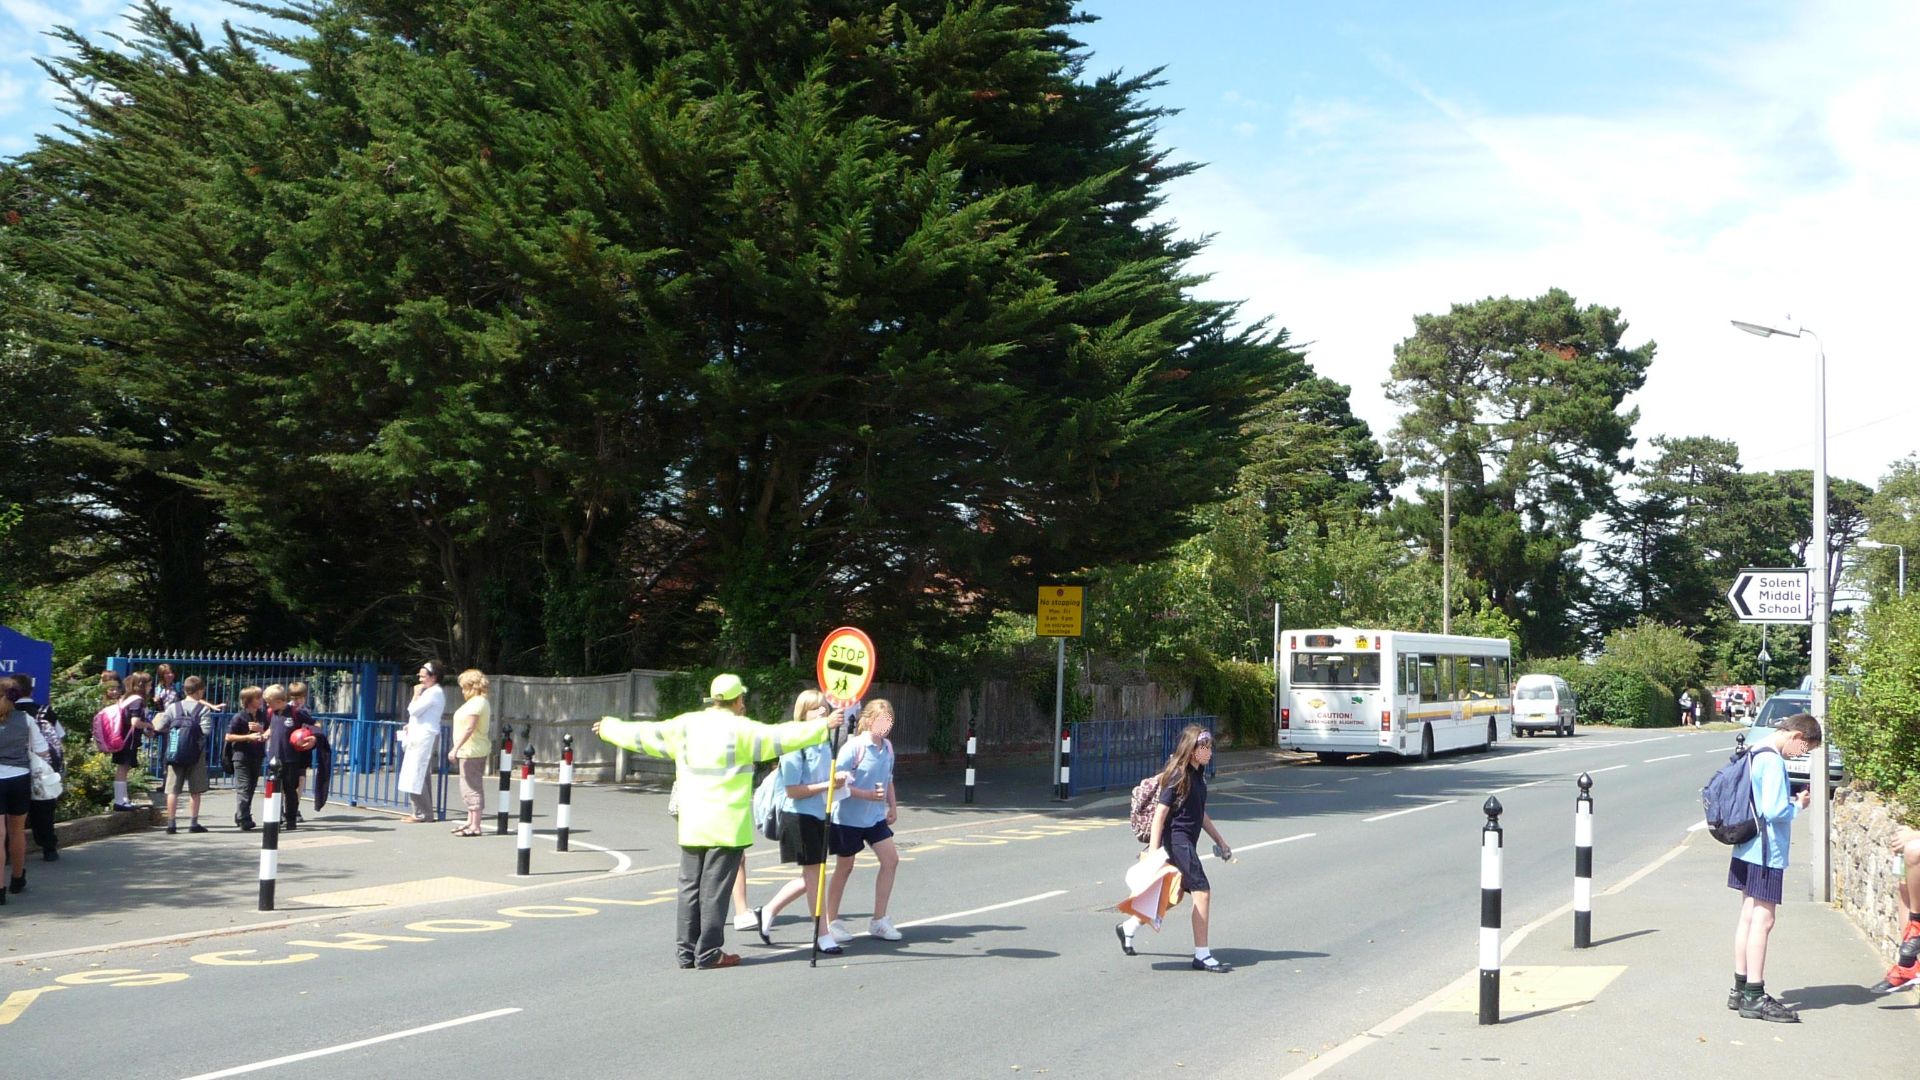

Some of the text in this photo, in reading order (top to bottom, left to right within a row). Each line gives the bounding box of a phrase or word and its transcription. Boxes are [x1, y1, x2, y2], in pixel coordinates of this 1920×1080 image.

[1759, 577, 1801, 588] Solent
[1759, 590, 1801, 601] Middle
[1051, 599, 1080, 607] stopping
[1758, 603, 1802, 614] School
[831, 645, 865, 662] STOP
[1316, 712, 1353, 720] CAUTION!
[55, 896, 677, 988] SCHOOL
